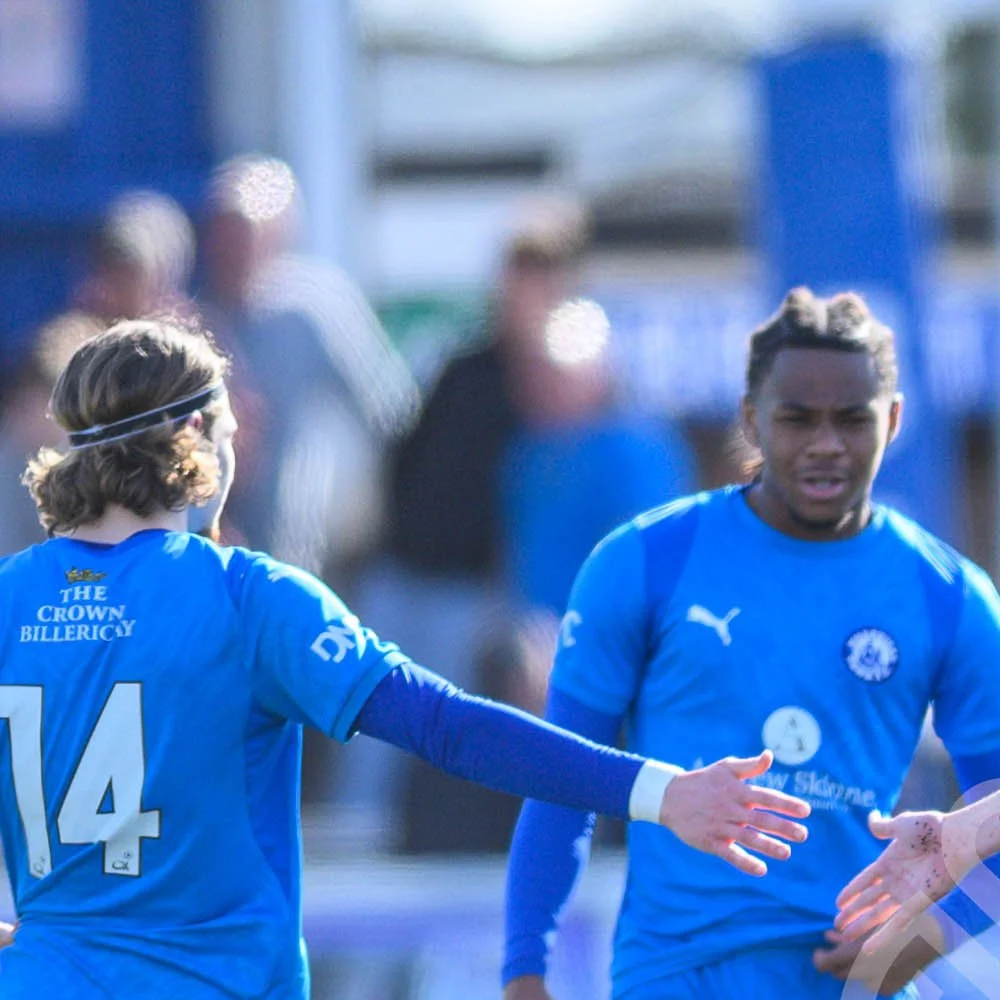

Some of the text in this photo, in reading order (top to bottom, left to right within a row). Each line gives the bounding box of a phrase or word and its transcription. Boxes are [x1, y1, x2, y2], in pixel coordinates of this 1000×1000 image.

[60, 585, 108, 603] THE
[37, 604, 126, 622] CROWN
[0, 681, 161, 879] 14
